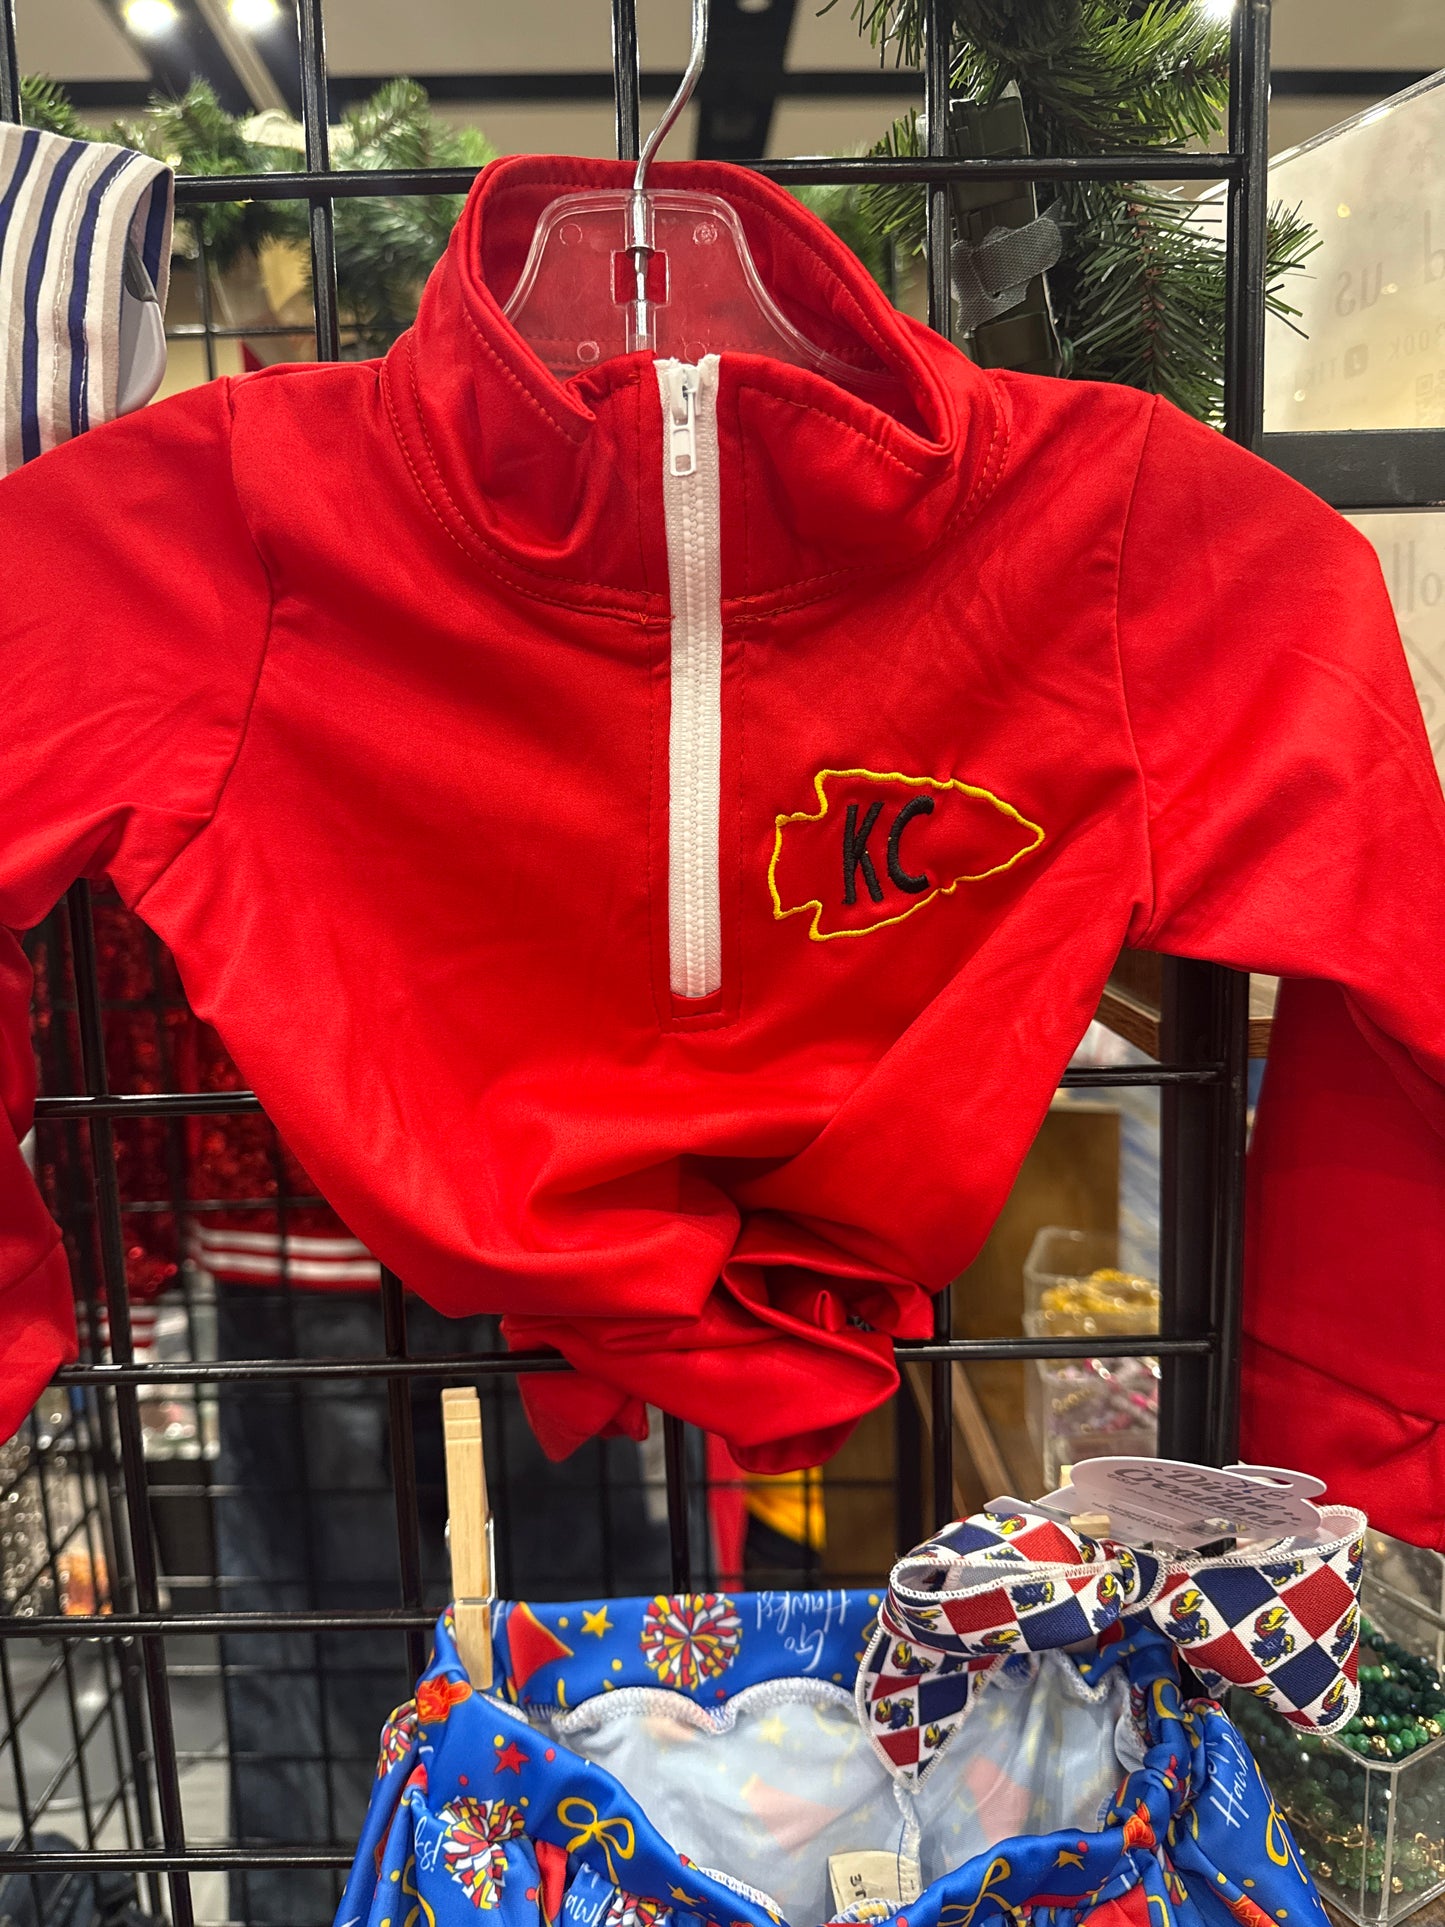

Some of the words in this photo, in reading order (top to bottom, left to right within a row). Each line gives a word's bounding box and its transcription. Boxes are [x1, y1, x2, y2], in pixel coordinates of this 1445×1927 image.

[842, 794, 936, 906] KC
[1113, 1468, 1289, 1526] Creations
[1162, 1469, 1288, 1511] Divine
[783, 1622, 825, 1673] Go
